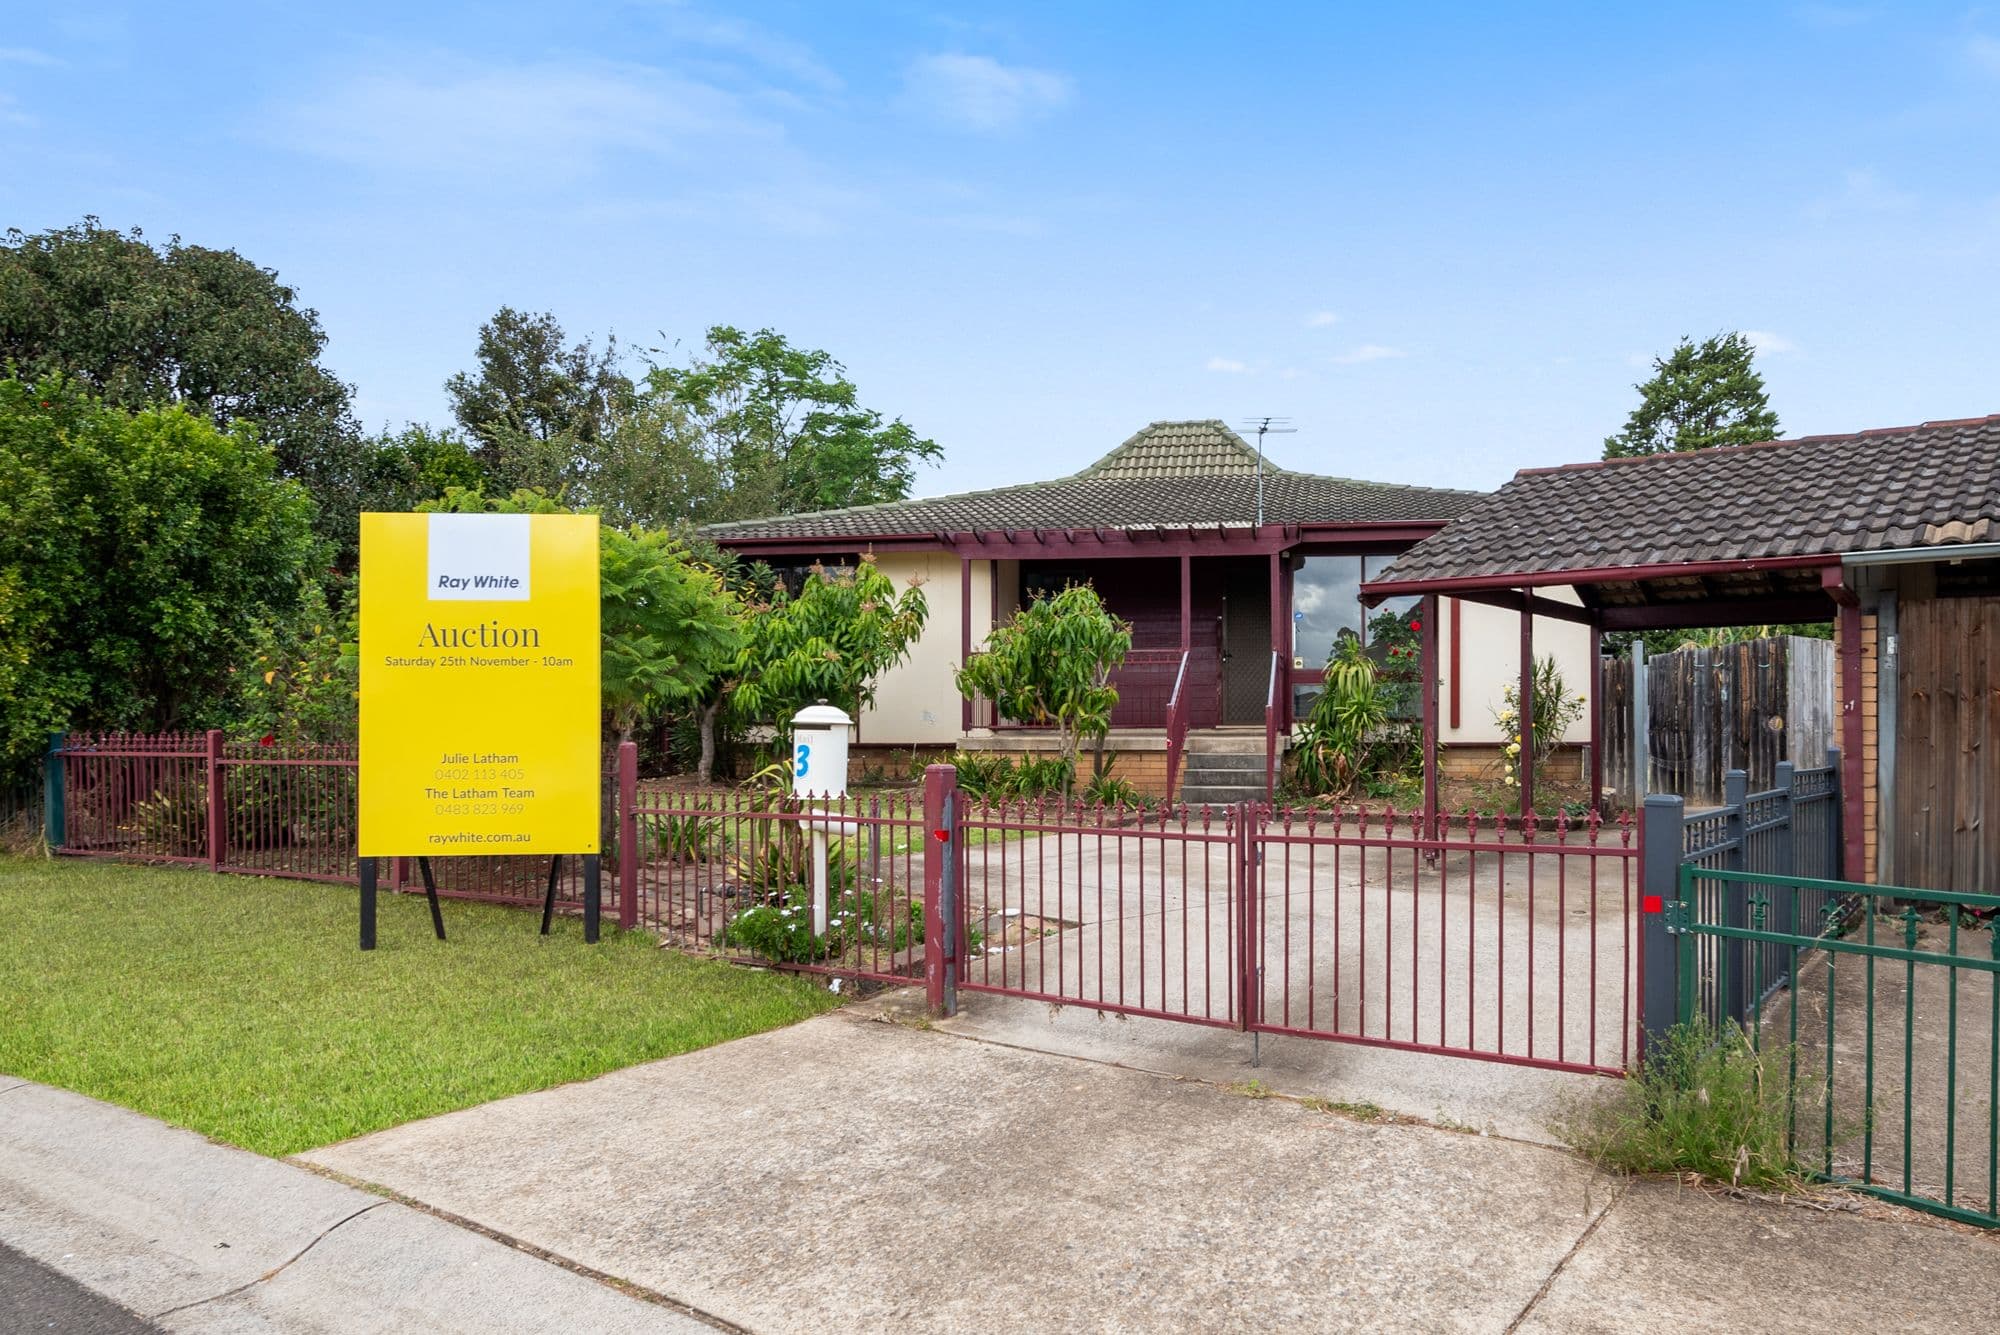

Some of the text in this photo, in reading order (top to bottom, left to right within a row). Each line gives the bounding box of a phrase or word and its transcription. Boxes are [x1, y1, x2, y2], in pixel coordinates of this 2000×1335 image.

[438, 575, 520, 591] Ray White
[418, 620, 540, 648] Auction
[385, 656, 436, 668] Saturday
[440, 656, 466, 667] 25th
[470, 656, 530, 667] November
[542, 656, 573, 667] 10am
[441, 753, 518, 764] Julie Latham
[796, 744, 810, 777] 3
[434, 769, 524, 780] 0402 113 405
[424, 788, 534, 799] The Latham Team
[435, 803, 524, 815] 0483 823 969
[429, 832, 531, 845] raywhite.com.au
